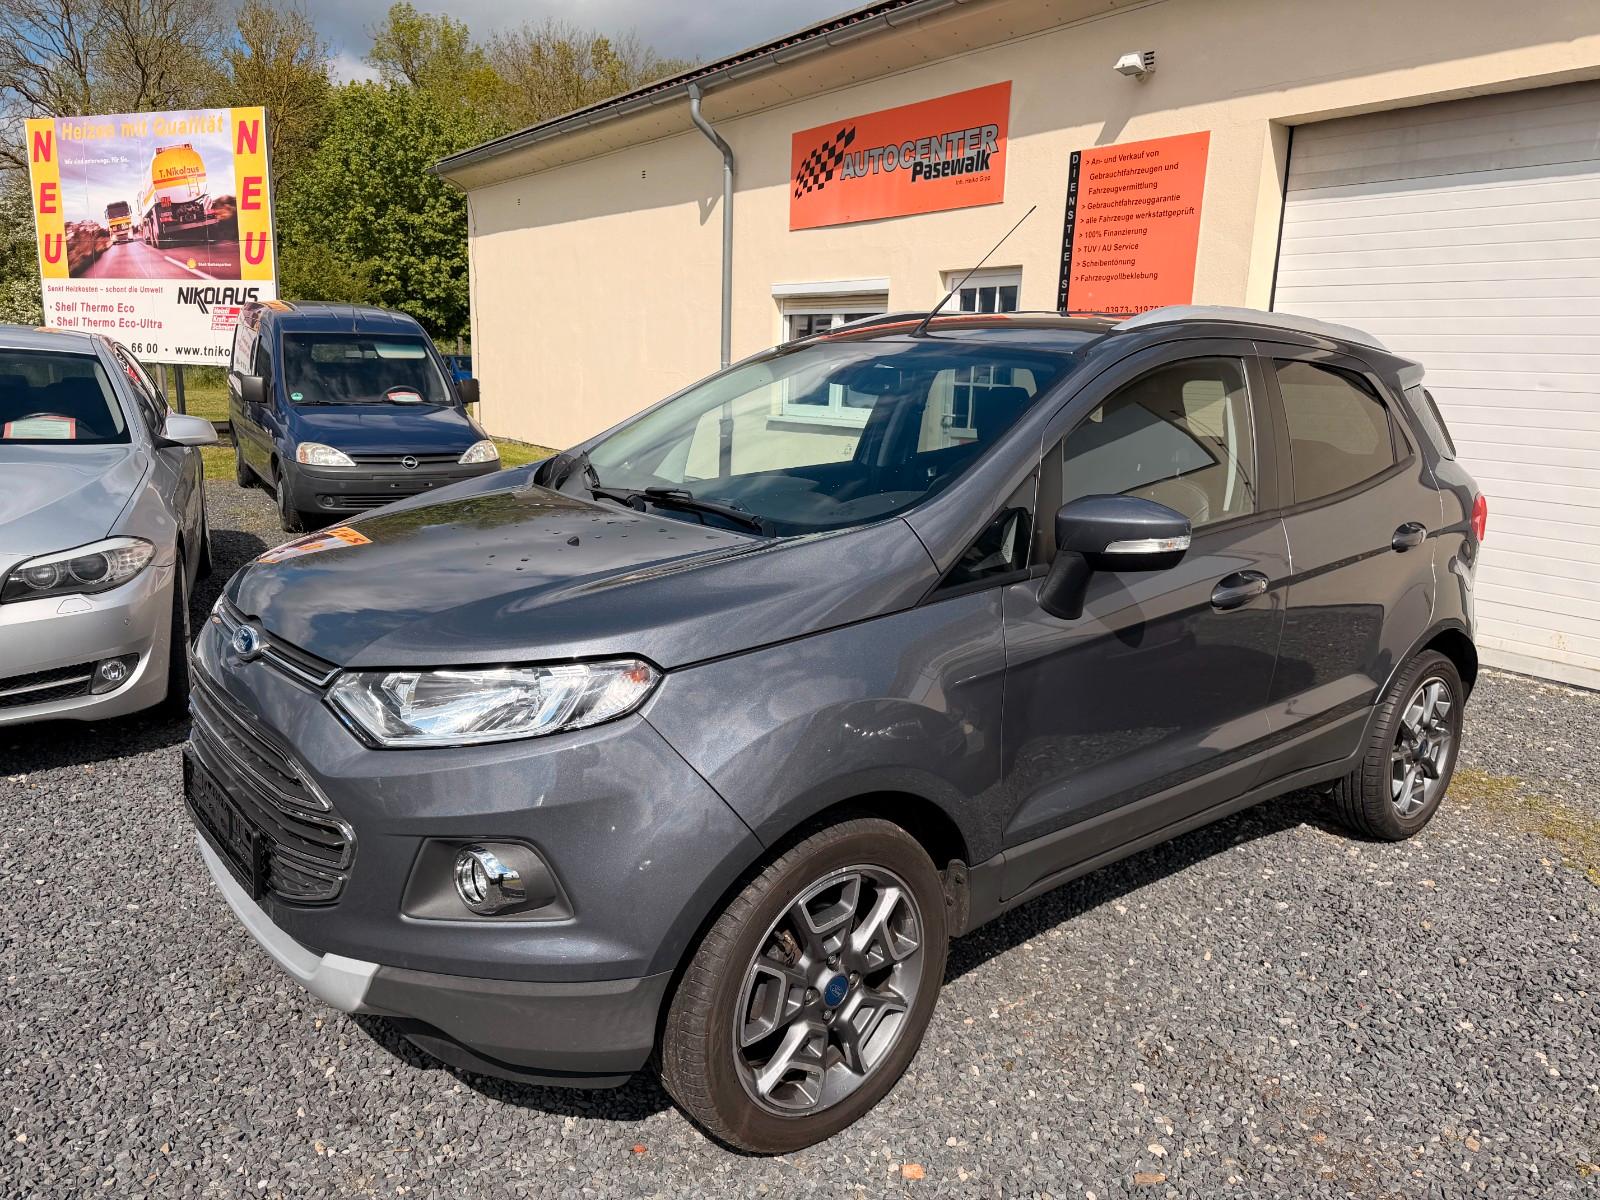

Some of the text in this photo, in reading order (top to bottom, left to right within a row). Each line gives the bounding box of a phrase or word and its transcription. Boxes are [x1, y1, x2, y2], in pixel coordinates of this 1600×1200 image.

[61, 113, 225, 141] Heizen mit Qualität
[839, 123, 1000, 181] AUTOCENTER
[1104, 154, 1117, 164] und
[1118, 150, 1145, 162] Verkauf
[1145, 150, 1160, 158] von
[911, 150, 992, 183] Pasewalk
[1089, 161, 1179, 181] Gebrauchtfahrzeugen und
[236, 119, 266, 265] NEU
[1088, 180, 1158, 196] Fahrzeugvermittlung
[33, 130, 63, 264] NEU
[1087, 193, 1181, 210] Gebrauchtfahrzeuggarantie
[1085, 206, 1195, 225] alle Fahrzeuge werkstattgeprüft
[1084, 226, 1148, 239] 100% Finanzierung
[1102, 244, 1112, 252] AU
[1113, 242, 1139, 251] Service
[1080, 271, 1158, 283] Fahrzeugvollbeklebung
[65, 285, 98, 293] Heizkosten
[105, 285, 127, 293] schont
[128, 285, 138, 293] die
[140, 285, 163, 294] Umwelt
[55, 301, 135, 313] Shell Thermo Eco
[177, 286, 260, 314] NIKOLAUS
[56, 316, 163, 329] Shell Thermo Eco-Ultra
[131, 342, 231, 357] 66 00 www.tniko
